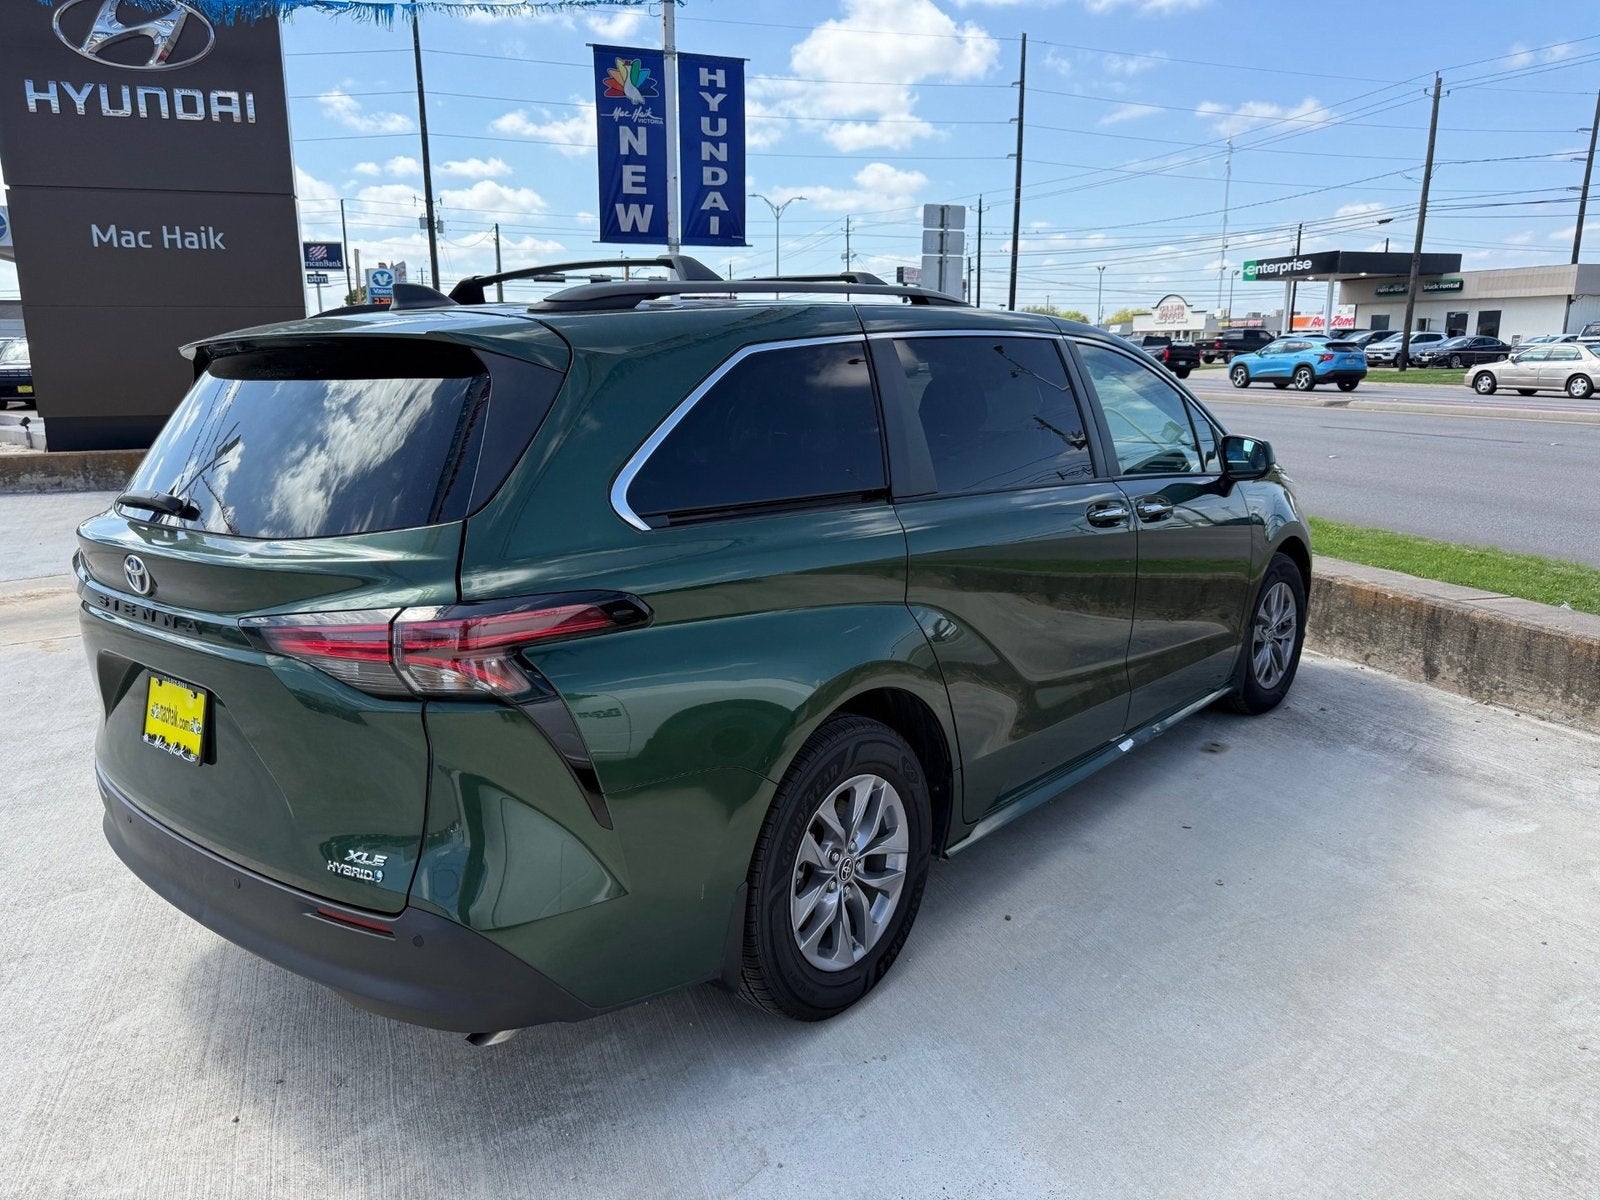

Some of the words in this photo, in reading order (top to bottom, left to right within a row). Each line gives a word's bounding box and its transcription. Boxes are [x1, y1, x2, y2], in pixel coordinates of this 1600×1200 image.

[24, 79, 257, 124] HYUNDAI
[699, 68, 729, 235] HYUNDAI
[615, 126, 653, 233] NEW
[90, 224, 153, 250] Mac
[162, 225, 226, 250] Haik
[304, 259, 342, 268] ricanBank
[1245, 258, 1313, 276] enterprise
[308, 275, 327, 283] atm
[98, 595, 202, 635] SIENNA
[344, 849, 388, 867] XLE
[326, 860, 374, 881] HYBRID
